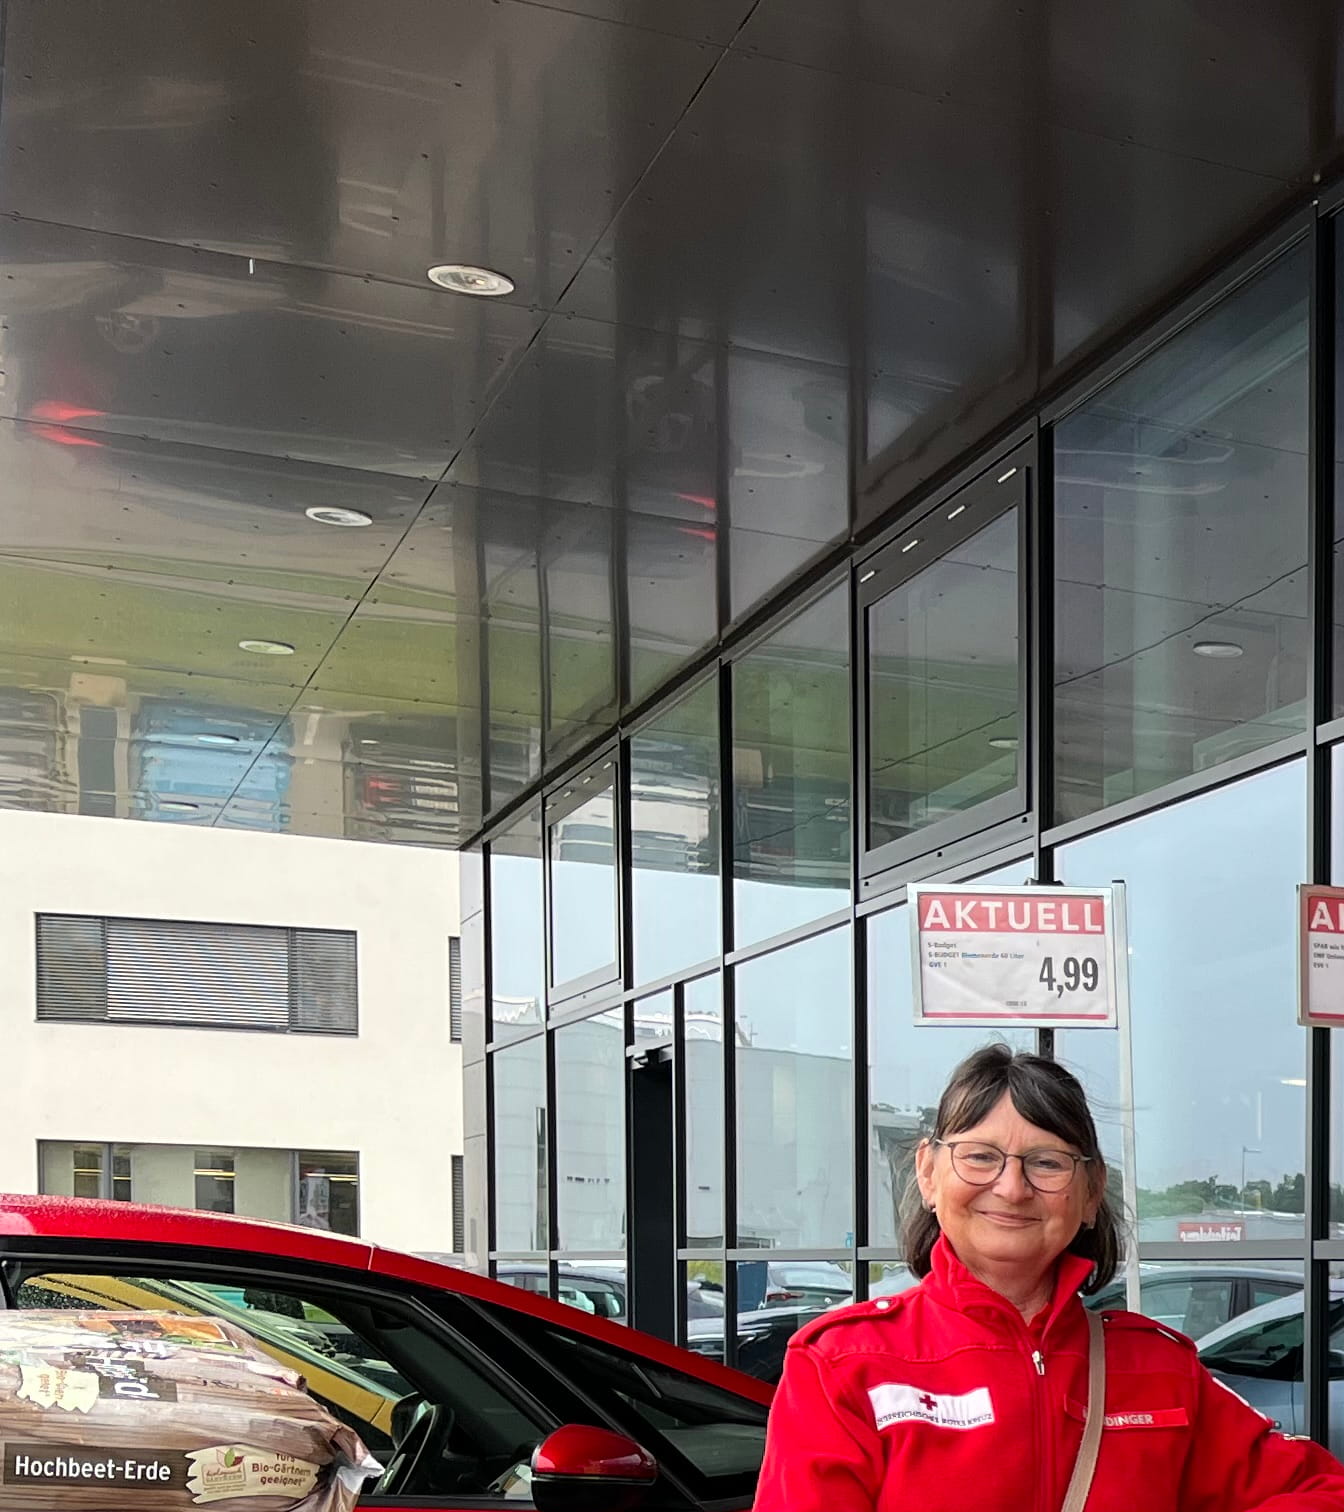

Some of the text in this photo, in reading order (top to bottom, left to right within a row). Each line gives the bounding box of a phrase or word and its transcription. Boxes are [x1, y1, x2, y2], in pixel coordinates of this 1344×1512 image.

[924, 899, 1102, 931] AKTUELL
[1039, 956, 1099, 999] 4,99
[1103, 1413, 1154, 1427] DINGER
[14, 1455, 171, 1481] Hochbeet-Erde
